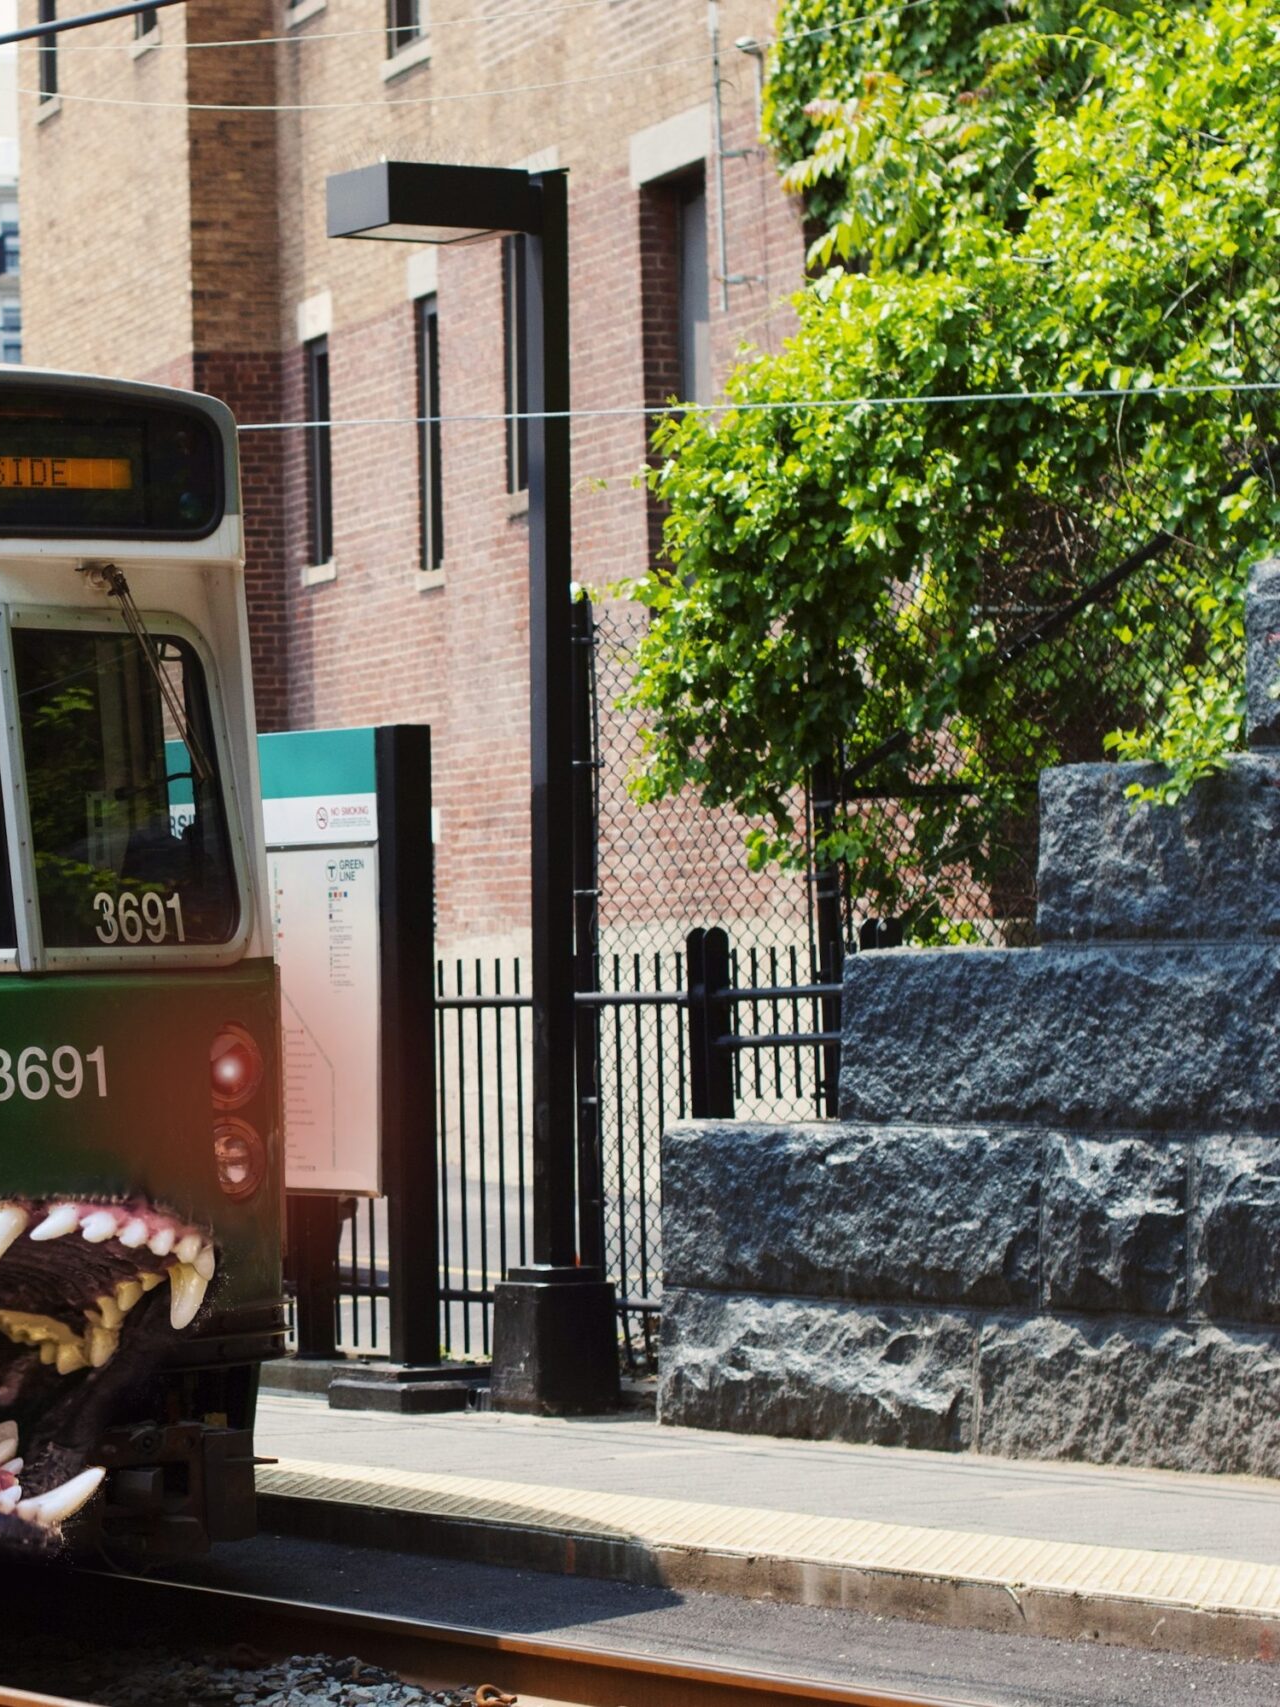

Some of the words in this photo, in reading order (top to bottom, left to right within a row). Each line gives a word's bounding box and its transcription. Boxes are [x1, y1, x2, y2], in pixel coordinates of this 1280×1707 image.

[330, 808, 339, 816] NO
[341, 806, 369, 815] SMOKING
[339, 859, 365, 869] GREEN
[339, 871, 356, 881] LINE
[93, 891, 186, 944] 3691
